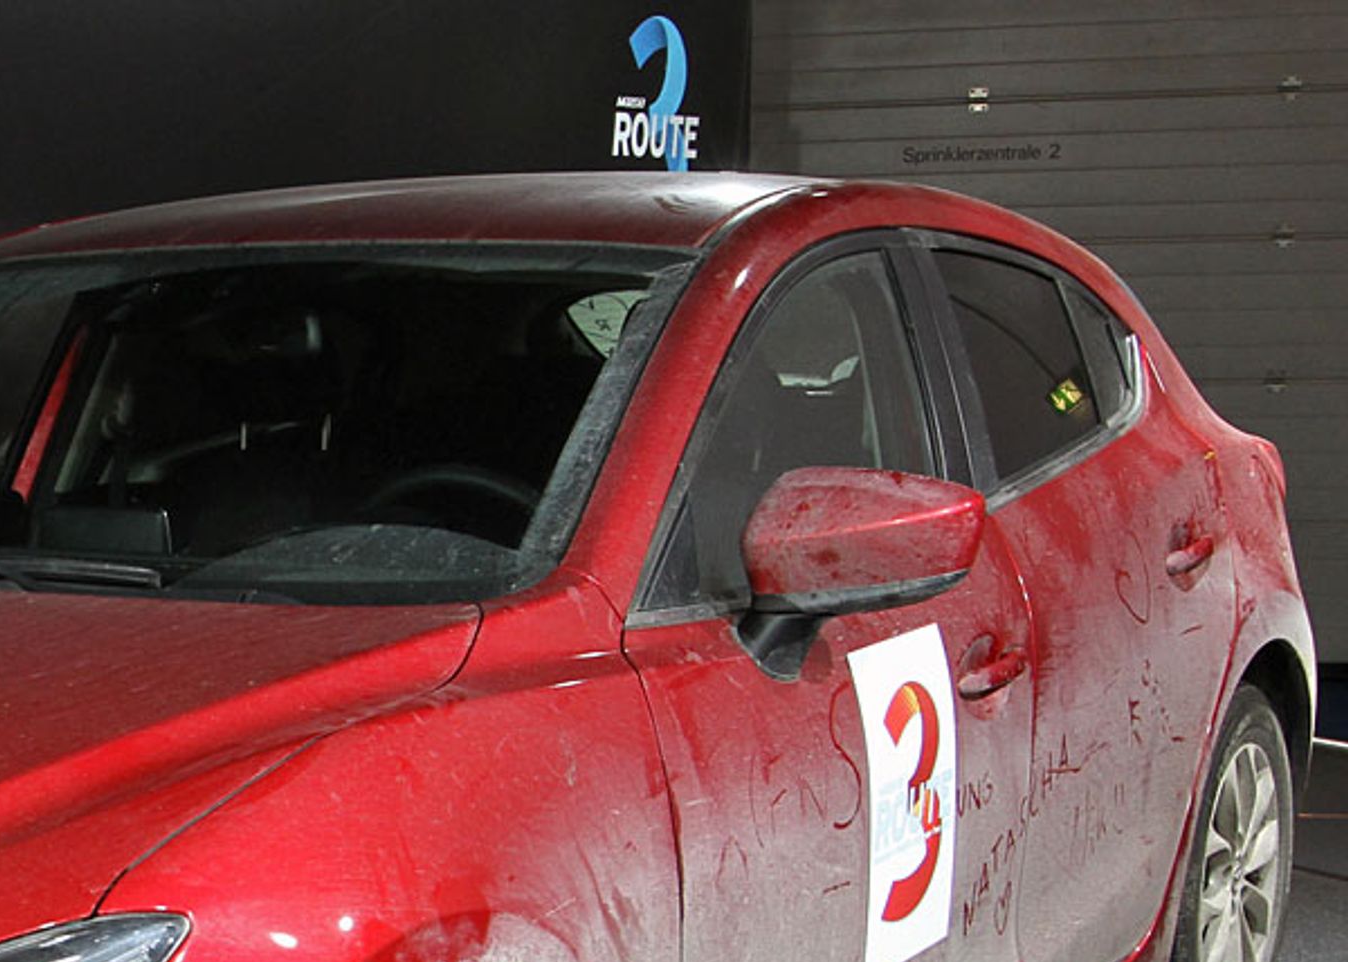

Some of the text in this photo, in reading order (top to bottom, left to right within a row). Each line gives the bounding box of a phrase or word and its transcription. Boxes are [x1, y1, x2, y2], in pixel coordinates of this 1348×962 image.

[612, 111, 700, 159] ROUTE
[902, 143, 1062, 166] Sprinklerzentrale 2
